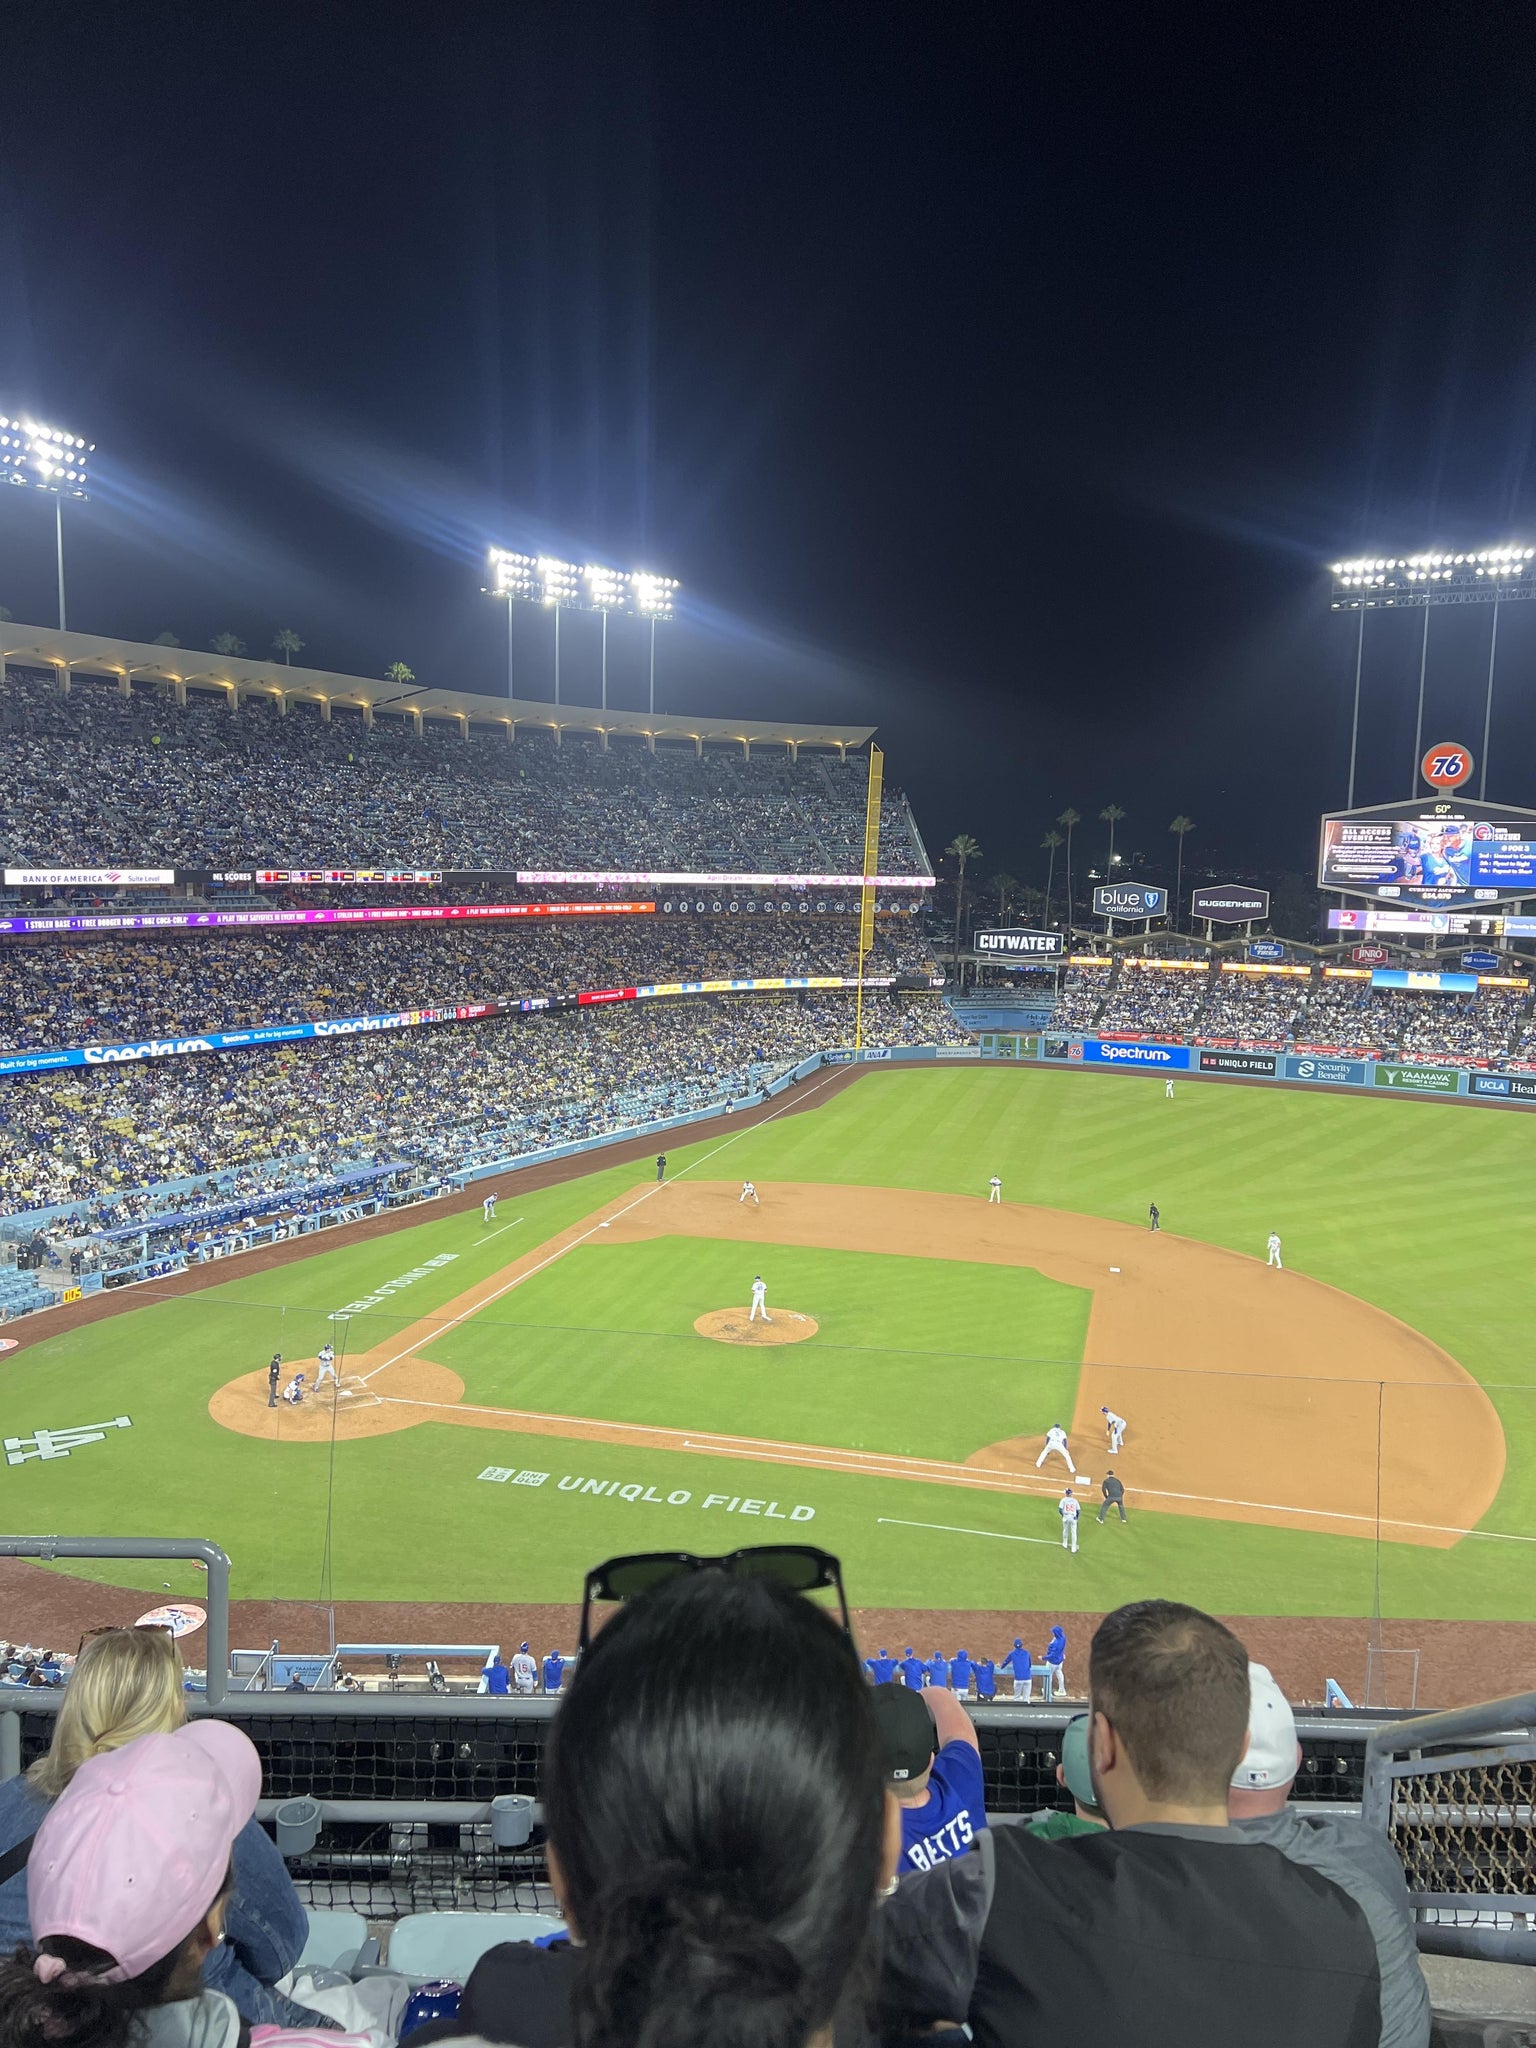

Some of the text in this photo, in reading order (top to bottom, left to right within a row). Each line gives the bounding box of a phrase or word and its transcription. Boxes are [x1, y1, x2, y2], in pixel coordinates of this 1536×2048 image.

[1432, 754, 1463, 777] 76
[224, 873, 251, 881] SCORES
[1101, 890, 1140, 905] blue
[1199, 900, 1262, 908] GUGGENHEIM
[30, 920, 53, 929] STOLEN
[55, 920, 71, 928] BASE
[82, 919, 96, 927] FREE
[980, 934, 1055, 951] CUTWATER
[1358, 949, 1382, 959] JINRO
[222, 1034, 248, 1044] Spectrum
[273, 1031, 281, 1039] big
[1101, 1044, 1166, 1060] Spectrum
[26, 1059, 37, 1068] big
[1218, 1059, 1248, 1068] UNIQLO
[1249, 1061, 1274, 1070] FIELD
[1318, 1062, 1352, 1073] Security
[1317, 1071, 1346, 1080] Benefit
[1480, 1081, 1505, 1090] UCLA
[327, 1267, 436, 1320] UNIQLO FIELD
[557, 1475, 815, 1521] UNIQLO FIELD
[908, 1809, 974, 1872] BETTS
